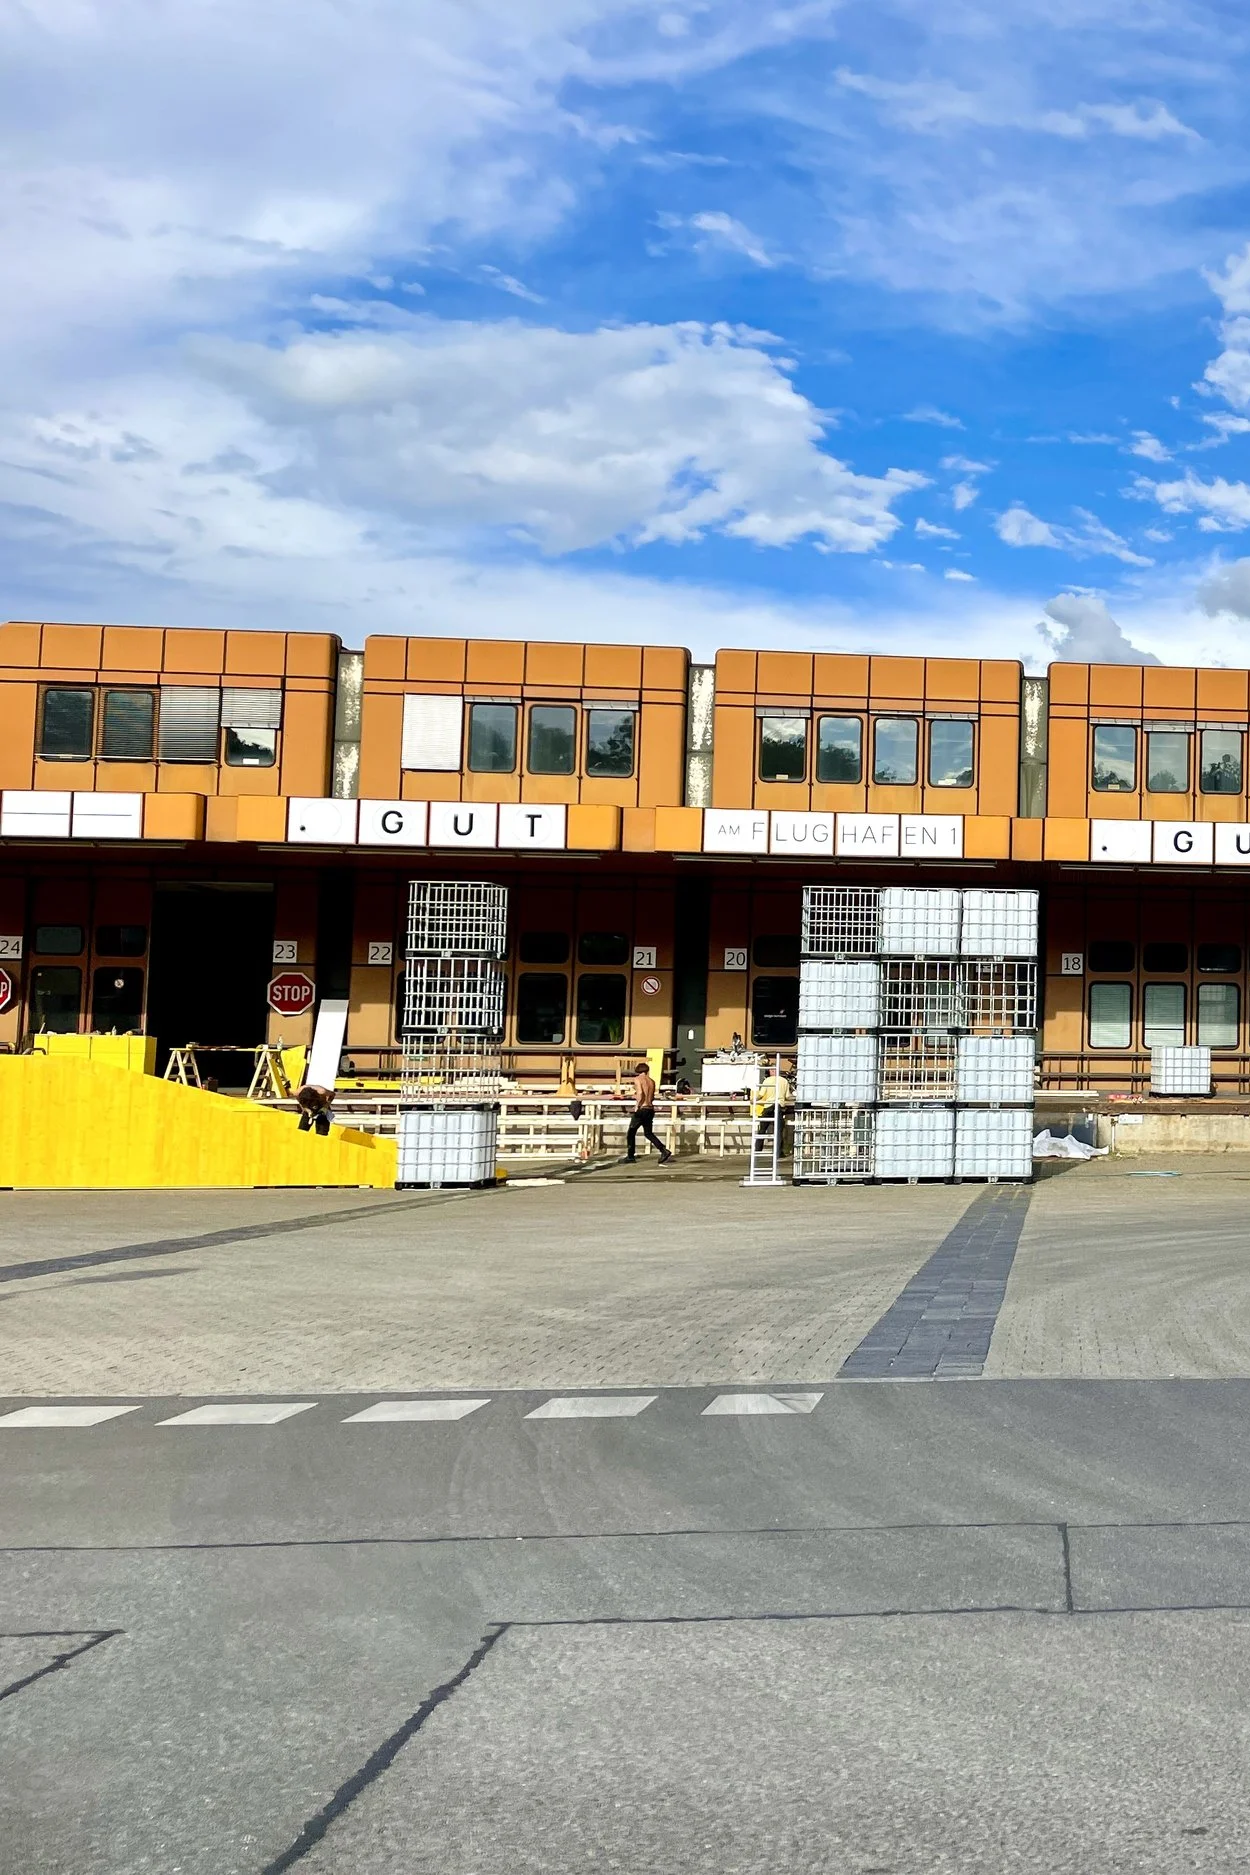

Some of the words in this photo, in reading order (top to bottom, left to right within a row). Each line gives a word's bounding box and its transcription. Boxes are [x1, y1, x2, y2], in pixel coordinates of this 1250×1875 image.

[718, 824, 741, 836] AM
[752, 822, 937, 845] FLUGHAFEN
[950, 827, 957, 845] 1
[0, 940, 20, 954] 24
[275, 945, 296, 959] 23
[370, 946, 391, 960] 22
[635, 952, 654, 966] 21
[726, 952, 746, 966] 20
[1063, 957, 1081, 971] 18
[272, 985, 310, 1001] STOP
